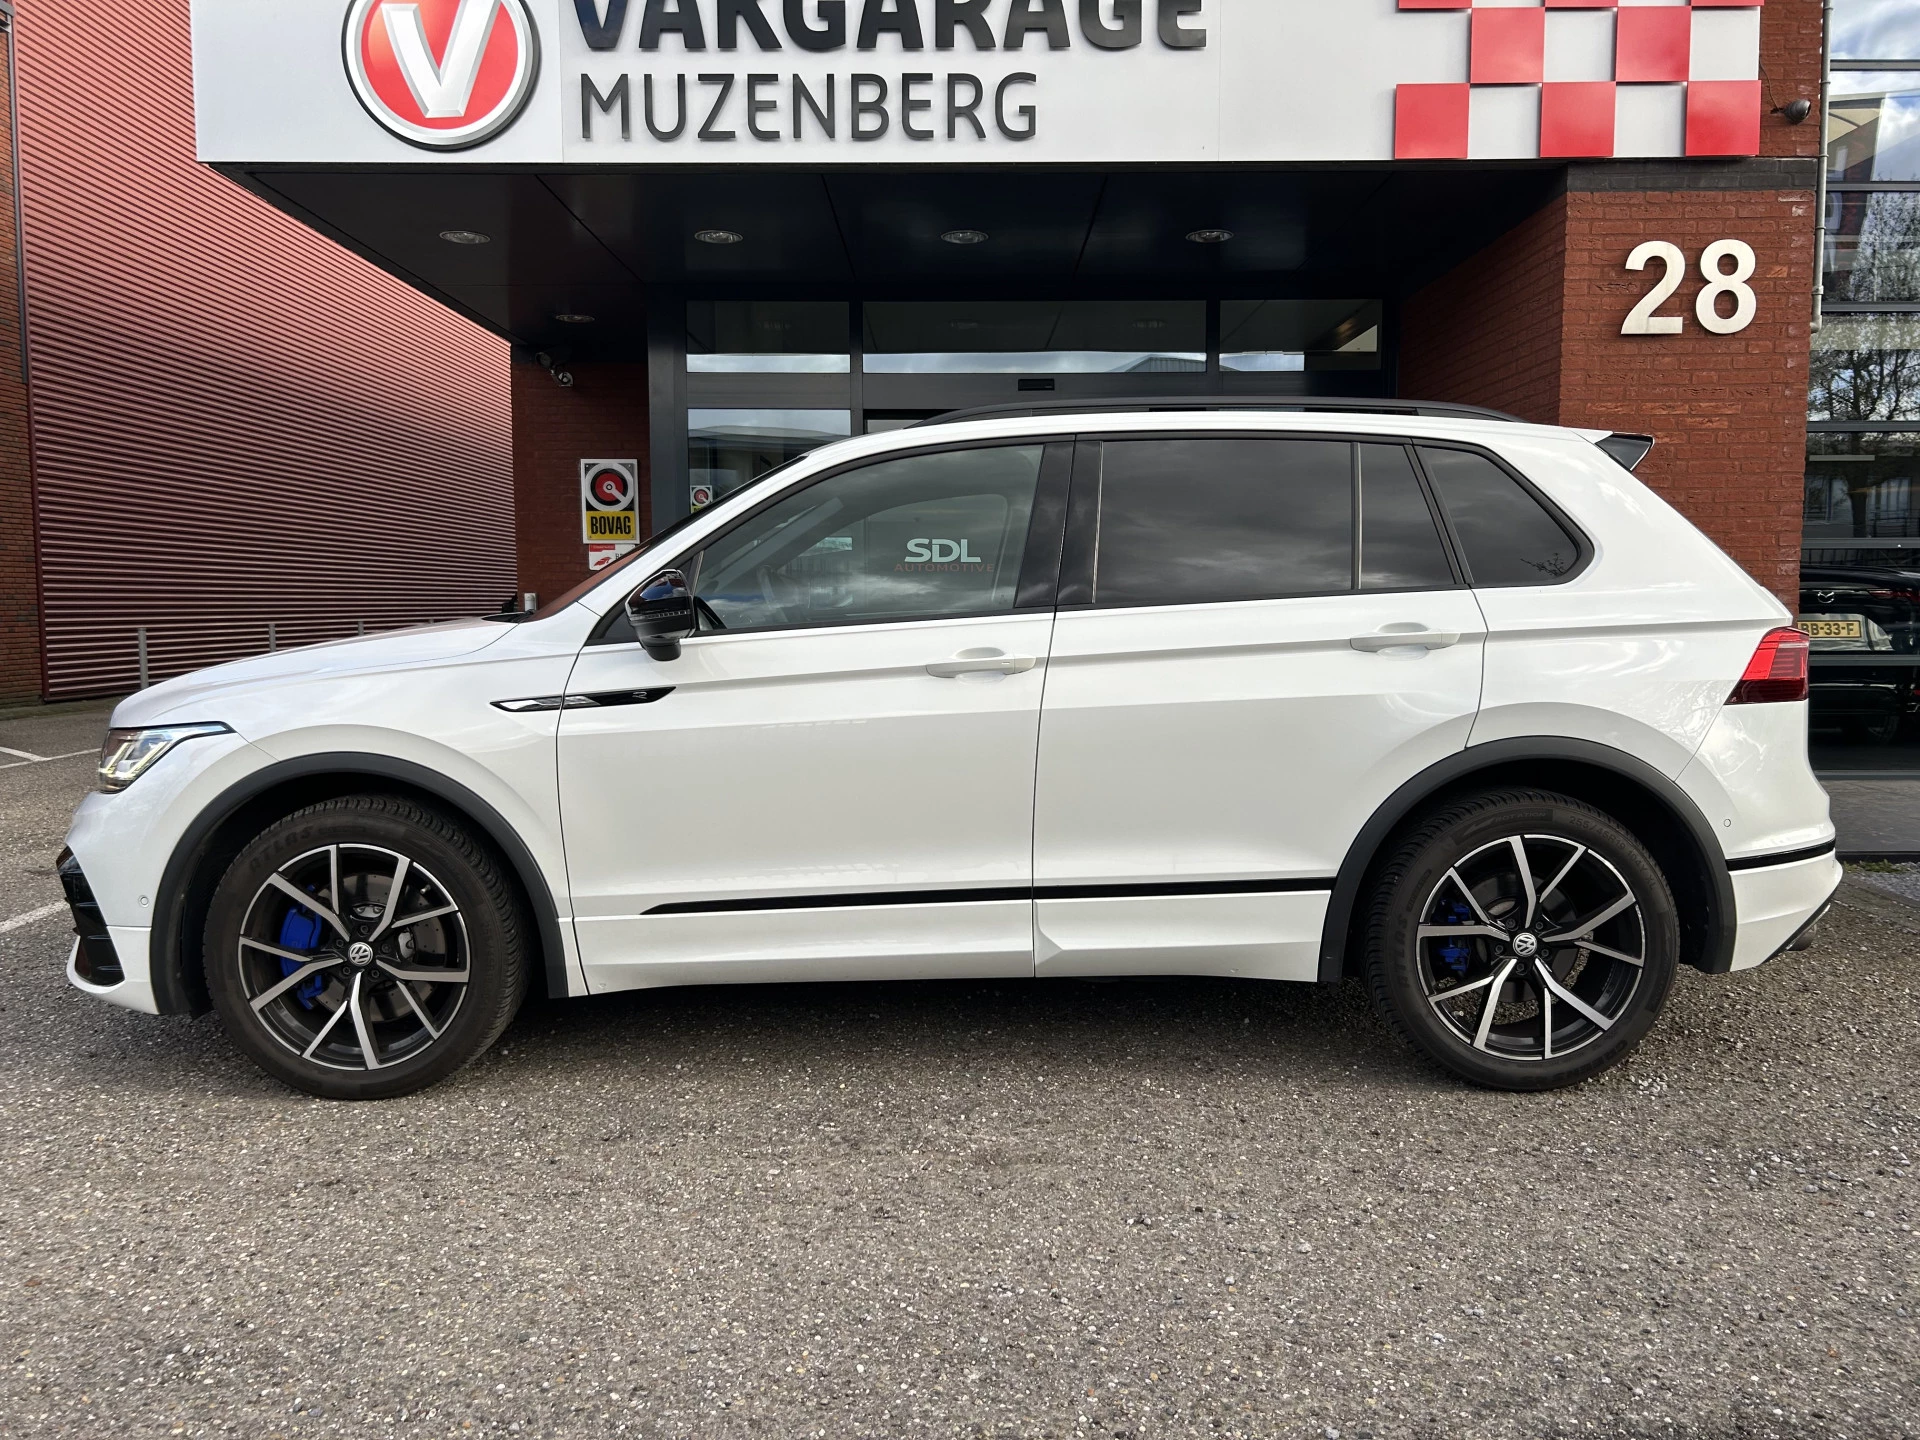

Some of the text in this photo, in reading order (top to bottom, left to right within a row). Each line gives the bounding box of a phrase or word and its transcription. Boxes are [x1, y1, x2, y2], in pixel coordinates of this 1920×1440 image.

[574, 0, 1207, 49] VAKGARAGE
[579, 72, 1038, 141] MUZENBERG
[1620, 238, 1757, 335] 28
[590, 515, 632, 535] BOVAG
[894, 563, 995, 573] AUTOMOTIVE
[904, 538, 982, 563] SDL
